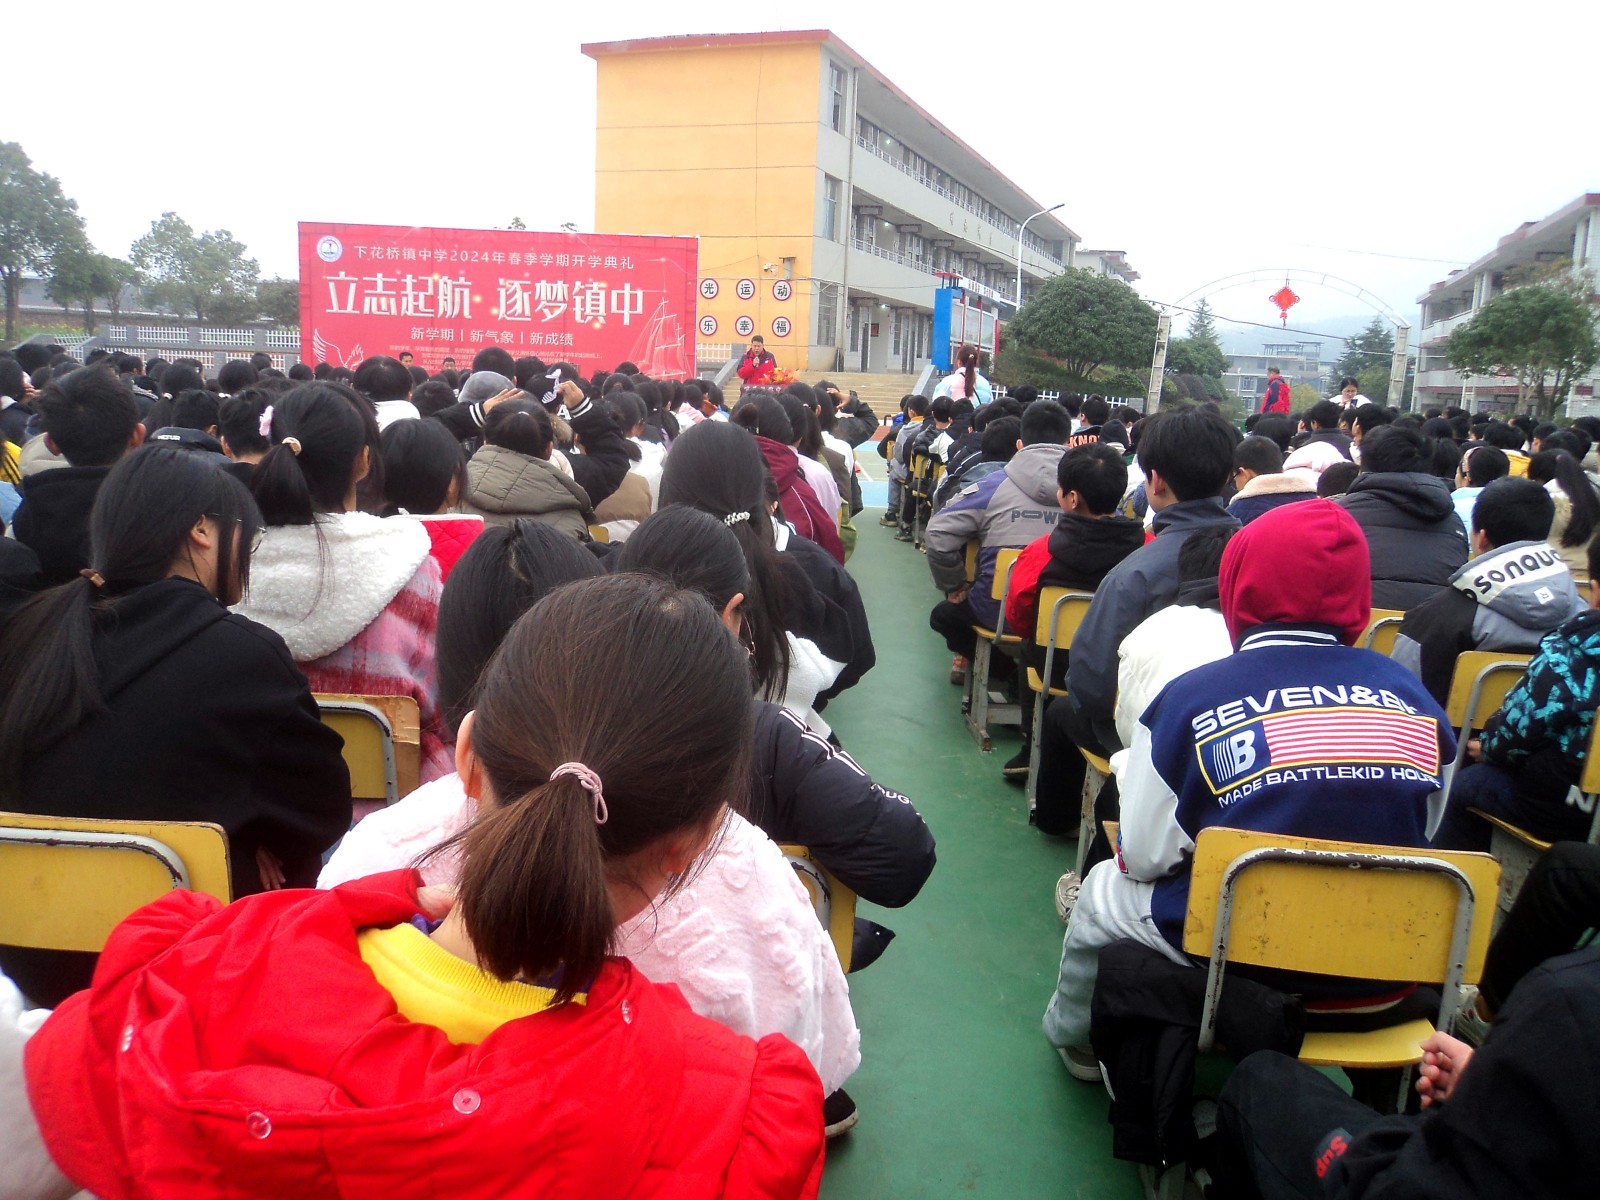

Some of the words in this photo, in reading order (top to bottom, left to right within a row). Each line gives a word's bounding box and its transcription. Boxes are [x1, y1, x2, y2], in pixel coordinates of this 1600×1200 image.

[354, 245, 634, 270] 下花桥镇中学2024年春季学期开学典礼
[325, 271, 472, 320] 立志起航
[497, 277, 644, 326] 逐梦镇中
[1068, 434, 1100, 448] KNO
[1011, 510, 1062, 524] POW
[1218, 777, 1262, 809] MADE
[1265, 766, 1384, 786] BATTLEKID
